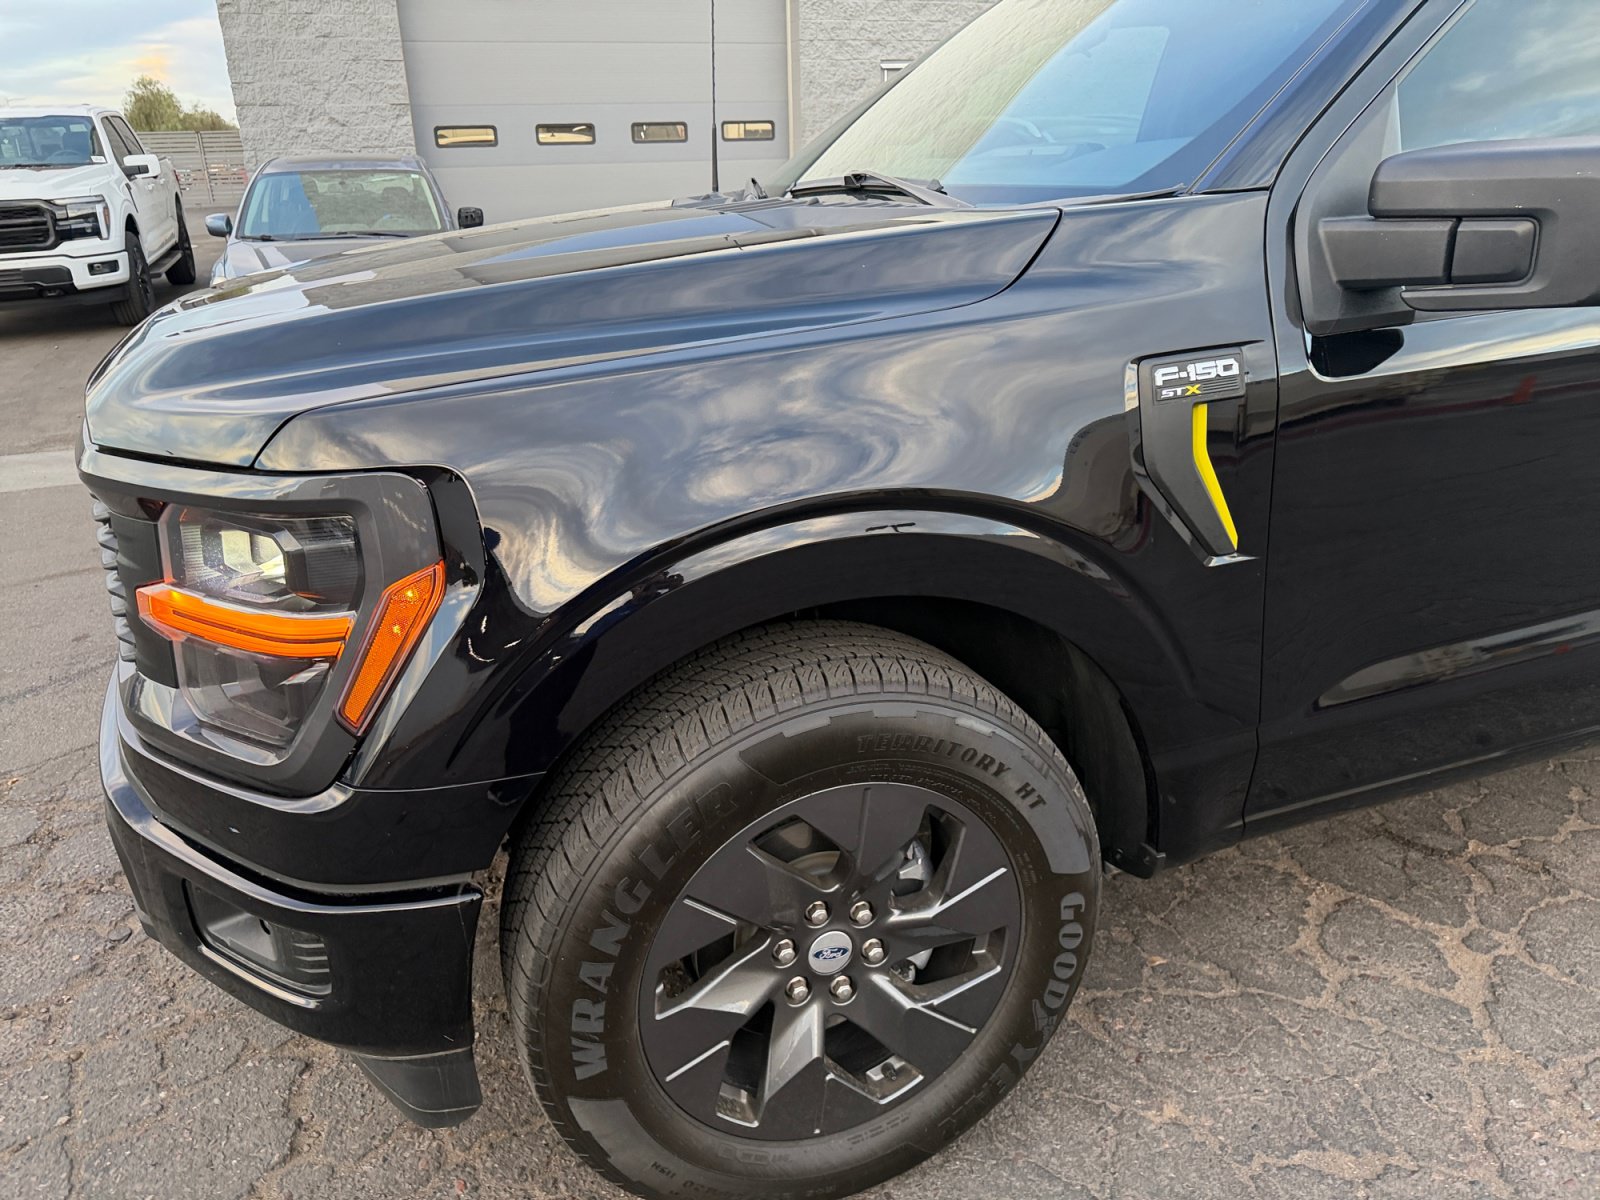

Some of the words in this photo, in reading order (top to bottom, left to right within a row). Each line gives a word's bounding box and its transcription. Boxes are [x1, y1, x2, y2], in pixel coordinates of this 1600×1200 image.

[1154, 358, 1240, 387] F-150
[1160, 384, 1202, 399] STX
[856, 733, 1011, 778] TERRITORY
[1015, 782, 1048, 810] HT
[571, 782, 739, 1081] WRANGLER
[817, 947, 845, 960] Ford
